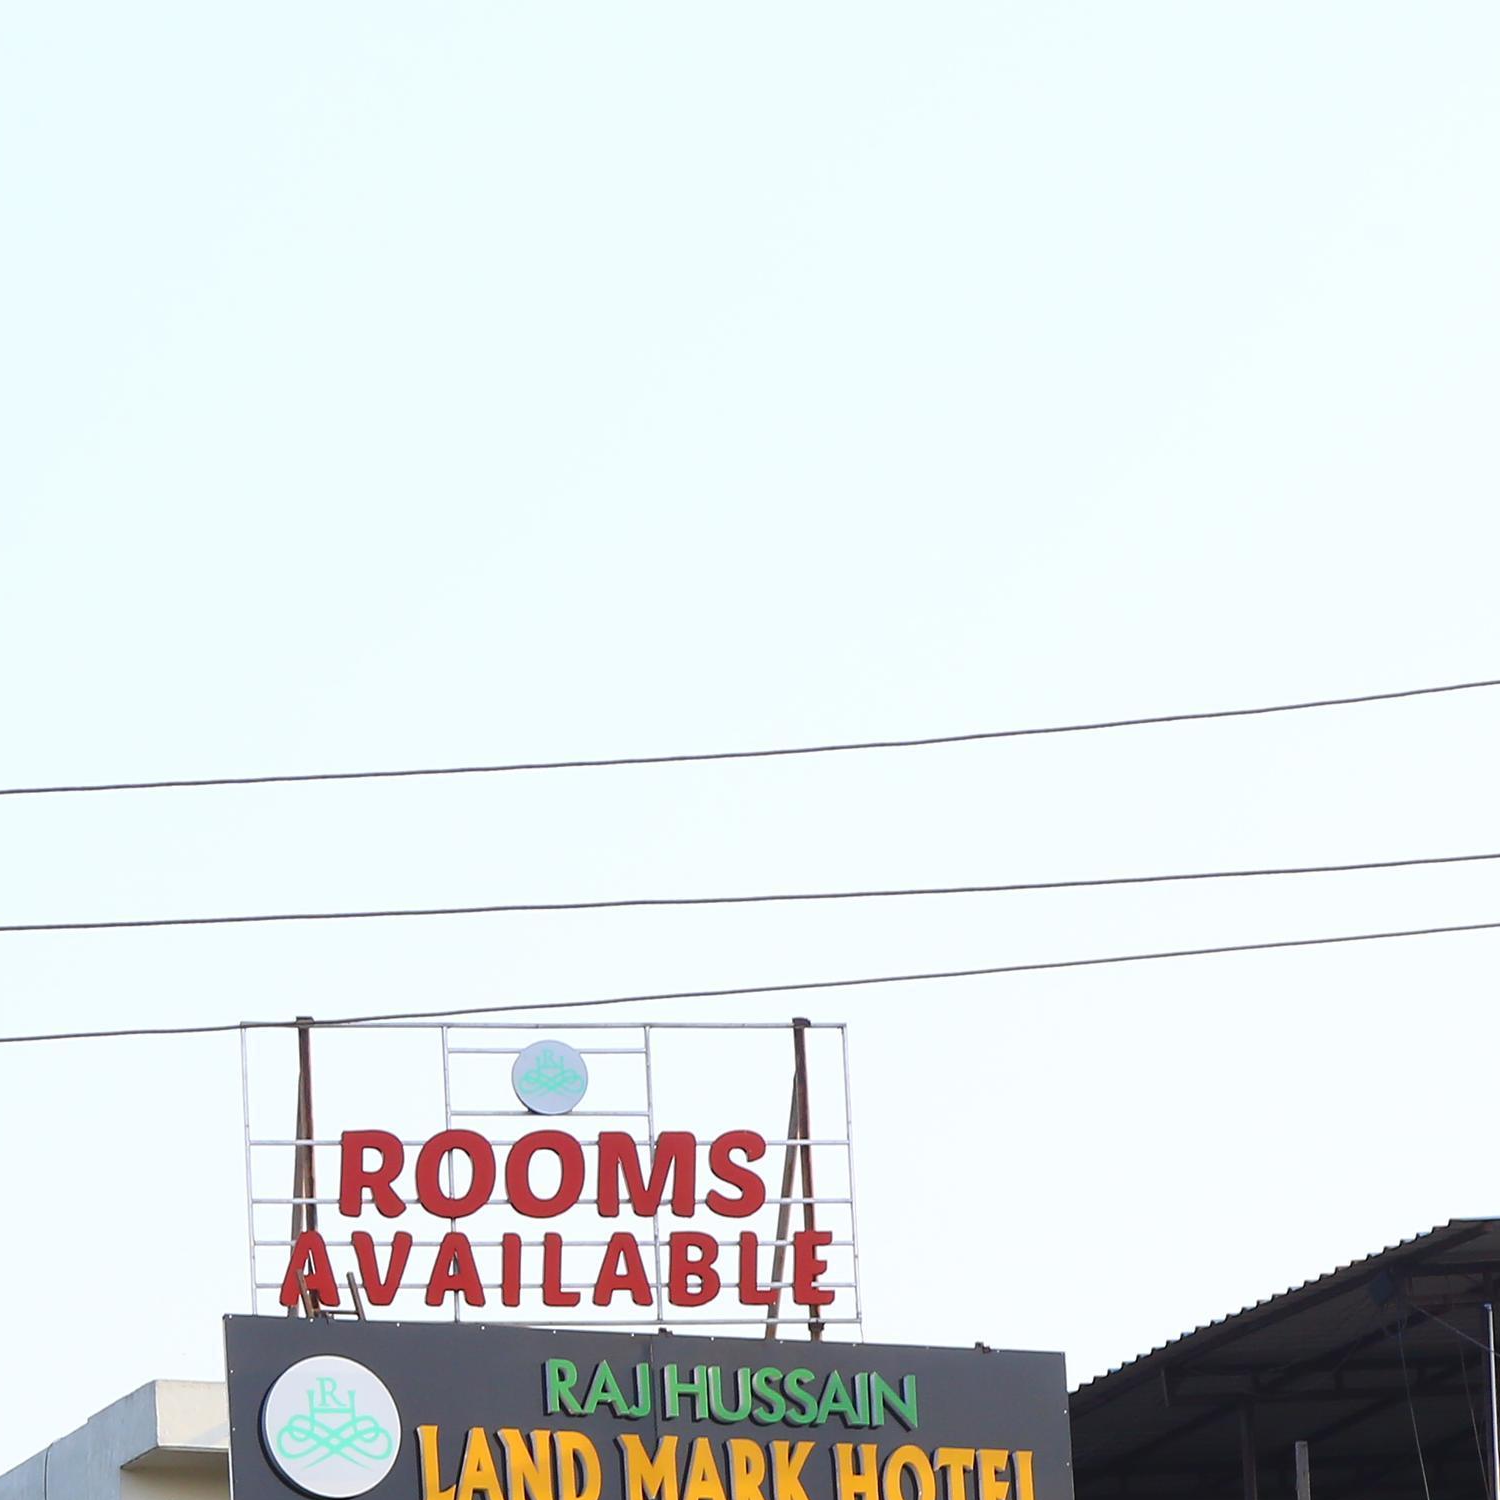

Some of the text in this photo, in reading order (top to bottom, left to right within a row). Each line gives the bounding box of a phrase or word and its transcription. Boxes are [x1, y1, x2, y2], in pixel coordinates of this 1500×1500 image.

[338, 1129, 766, 1218] ROOMS
[279, 1231, 835, 1307] AVAILABLE
[544, 1358, 919, 1430] RAJ HUSSAIN
